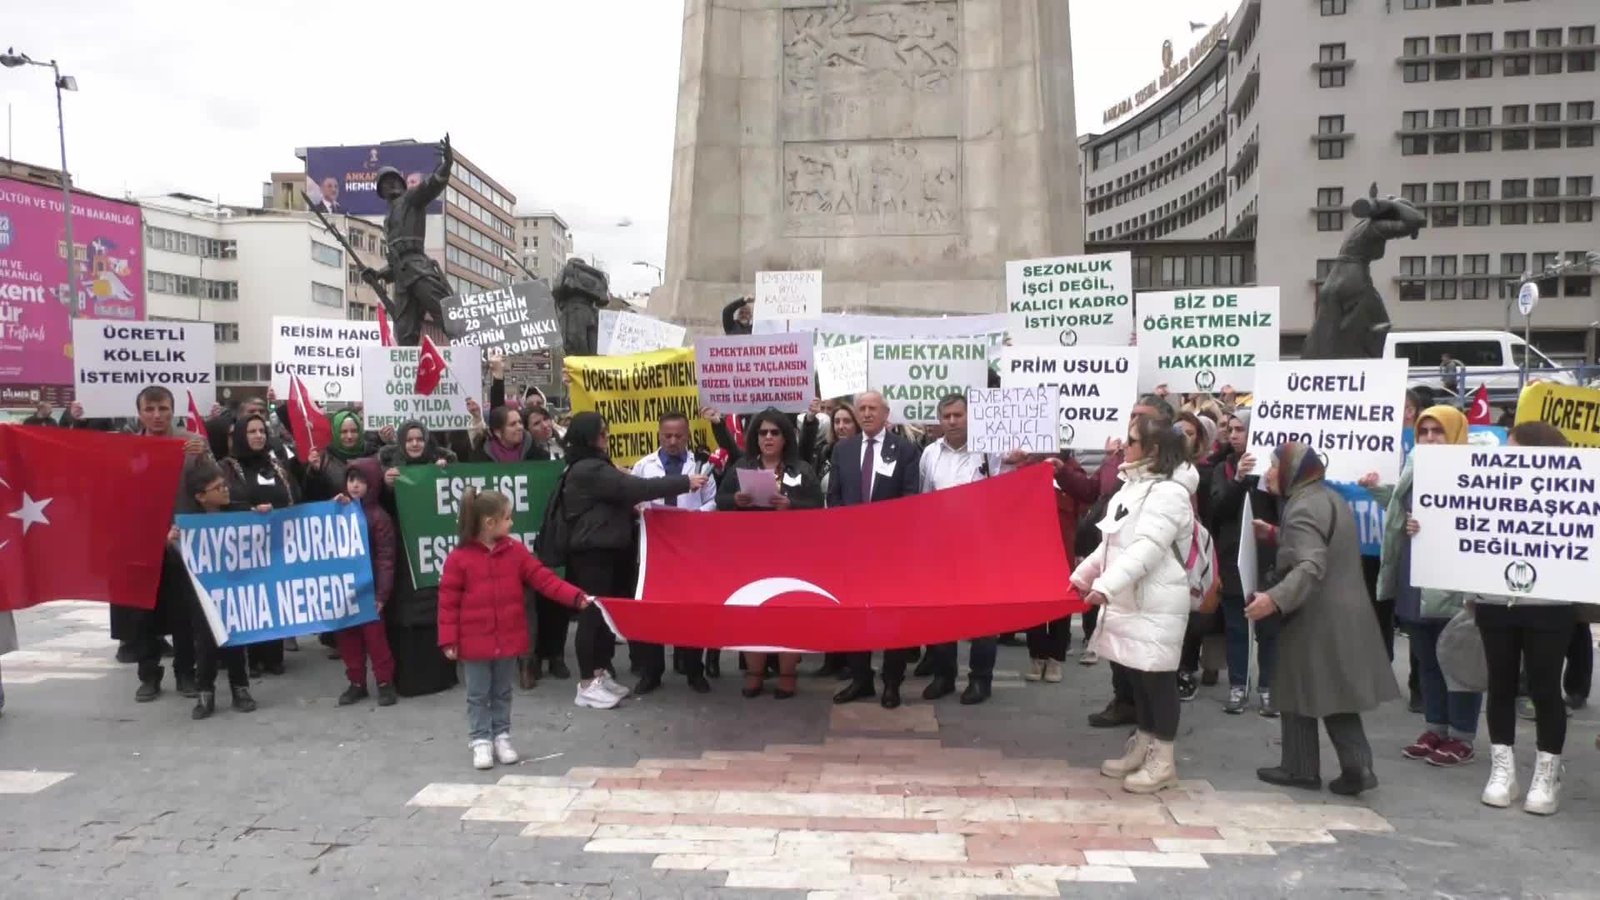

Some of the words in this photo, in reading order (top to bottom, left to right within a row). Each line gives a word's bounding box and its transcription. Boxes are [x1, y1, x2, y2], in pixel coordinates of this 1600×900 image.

[33, 197, 47, 209] VE
[48, 200, 86, 216] TUZM
[86, 208, 135, 226] BAKANLIĞI
[1023, 259, 1112, 277] SEZONLUK
[1060, 276, 1114, 292] DEĞİL,
[1010, 298, 1063, 312] KALICI
[1069, 294, 1128, 309] KADRO
[1174, 293, 1206, 309] BİZ
[1212, 294, 1238, 308] DE
[465, 320, 481, 331] 20
[520, 319, 557, 337] HAKKI
[1025, 313, 1114, 329] İSTİYORUZ
[1143, 310, 1272, 331] ÖĞRETMENİZ
[103, 324, 185, 341] ÜCRETLİ
[280, 323, 333, 339] REİSİM
[338, 328, 380, 340] HANG
[709, 345, 767, 358] EMEKTARIN
[769, 342, 798, 355] EMEĞİ
[1172, 334, 1240, 349] KADRO
[104, 347, 186, 362] KÖLELİK
[294, 345, 360, 359] MESLEĞİ
[390, 349, 452, 362] EMER
[873, 343, 985, 360] EMEKTARIN
[274, 360, 355, 377] ÜCRETLİSİ
[701, 362, 733, 374] KADRO
[736, 361, 752, 373] İLE
[753, 360, 807, 374] TAÇLANSIN
[1011, 356, 1057, 373] PRİM
[1063, 357, 1129, 373] USULÜ
[1158, 353, 1256, 369] HAKKIMIZ
[80, 368, 211, 384] İSTEMİYORUZ
[632, 361, 698, 391] ÖĞRETMENL
[908, 364, 948, 380] OYU
[385, 380, 459, 395] ÖĞRMEN
[733, 376, 765, 388] ÜLKEM
[768, 375, 809, 387] YENİDEN
[1038, 382, 1100, 397] AMA
[1287, 371, 1366, 392] ÜCRETLİ
[732, 392, 748, 403] İLE
[882, 384, 971, 400] KADROD
[969, 386, 1048, 404] EMEKTAR
[393, 399, 409, 412] 90
[413, 399, 452, 412] YILDA
[595, 399, 640, 424] ATANSIN
[643, 396, 700, 423] ATANMAYA
[903, 401, 936, 420] GİZ
[1257, 400, 1395, 422] ÖĞRETMENLER
[368, 413, 415, 428] EMEK
[985, 419, 1038, 435] KALICI
[607, 432, 654, 458] RETMEN
[1252, 430, 1312, 446] KADRO
[1318, 429, 1395, 452] İSTİYOR
[1471, 453, 1582, 470] MAZLUMA
[1457, 472, 1523, 490] SAHİP
[1530, 476, 1595, 495] ÇIKIN
[436, 476, 486, 523] EŞT
[1419, 494, 1600, 518] CUMHURBAŞKAN
[1455, 514, 1491, 532] BİZ
[1497, 519, 1594, 539] MAZLUM
[180, 523, 272, 574] KAYSERİ
[283, 512, 365, 564] BURADA
[1458, 537, 1590, 561] DEĞİLMİYİZ
[275, 572, 361, 627] NEREDE
